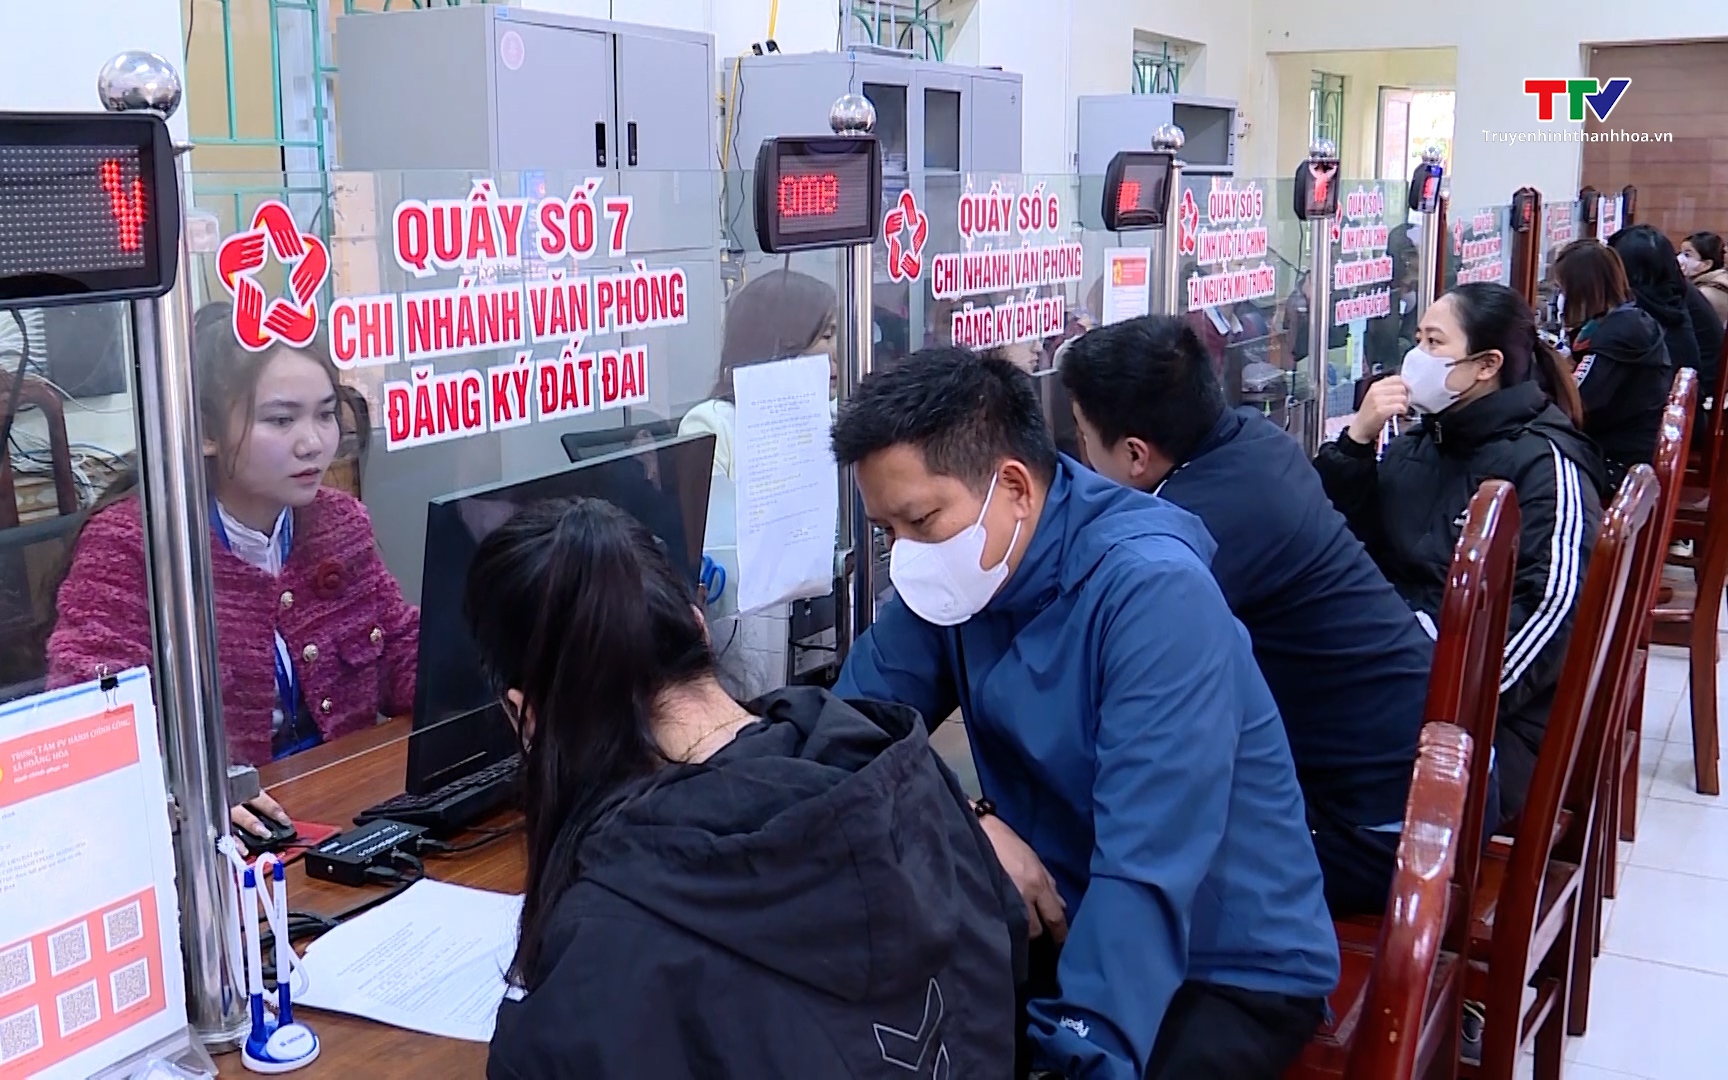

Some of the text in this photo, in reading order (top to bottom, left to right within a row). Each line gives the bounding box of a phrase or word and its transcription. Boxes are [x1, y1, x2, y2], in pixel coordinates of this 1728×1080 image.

[397, 183, 630, 270] QUẦY SỐ 7
[960, 183, 1058, 238] QUẦY SỐ 6
[1255, 193, 1262, 217] 5
[934, 239, 1082, 294] CHI NHÁNH VĂN PHÒNG
[333, 263, 684, 362] CHI NHÁNH VĂN PHÒNG
[954, 306, 992, 346] ĐĂNG
[997, 299, 1013, 342] KÝ
[1016, 291, 1040, 338] ĐẤT
[1043, 299, 1063, 332] ĐAI
[388, 340, 645, 442] ĐĂNG KÝ ĐẤT ĐAI
